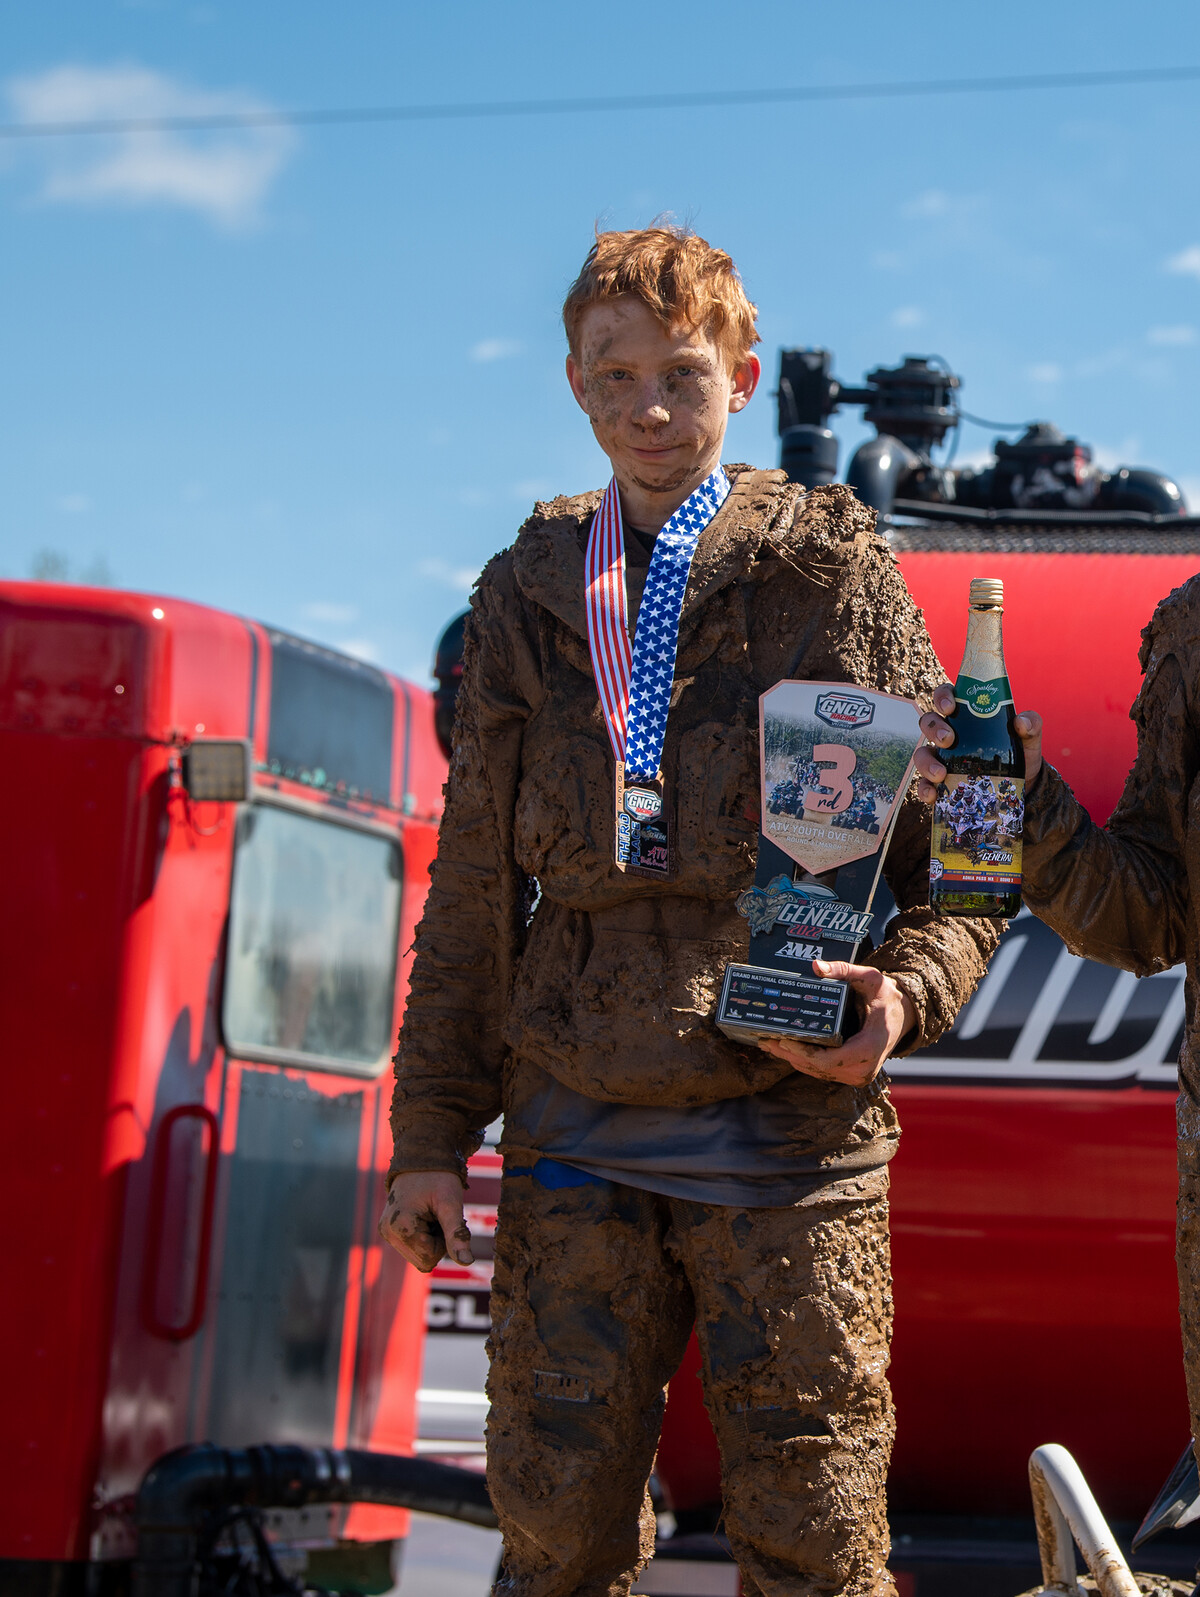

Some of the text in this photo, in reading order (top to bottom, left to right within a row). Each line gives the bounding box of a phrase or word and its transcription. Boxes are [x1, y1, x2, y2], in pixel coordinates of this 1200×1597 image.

[967, 684, 1000, 696] Sparkling
[821, 700, 871, 717] GNCC
[971, 703, 997, 712] WHITE GRAPE
[804, 744, 856, 813] 3
[629, 796, 660, 811] GNCC
[618, 813, 630, 862] THIRD
[770, 822, 872, 846] ATV YOUTH OVERALL
[631, 821, 640, 866] PLACE
[648, 846, 667, 860] ATV
[982, 853, 1013, 862] GENERAL
[810, 900, 850, 912] SPECIALIZED
[778, 904, 870, 934] GENERAL
[790, 924, 822, 938] 2022
[775, 941, 823, 961] AMA
[732, 971, 841, 993] GRAND NATIONAL CROSS COUNTRY SERIES
